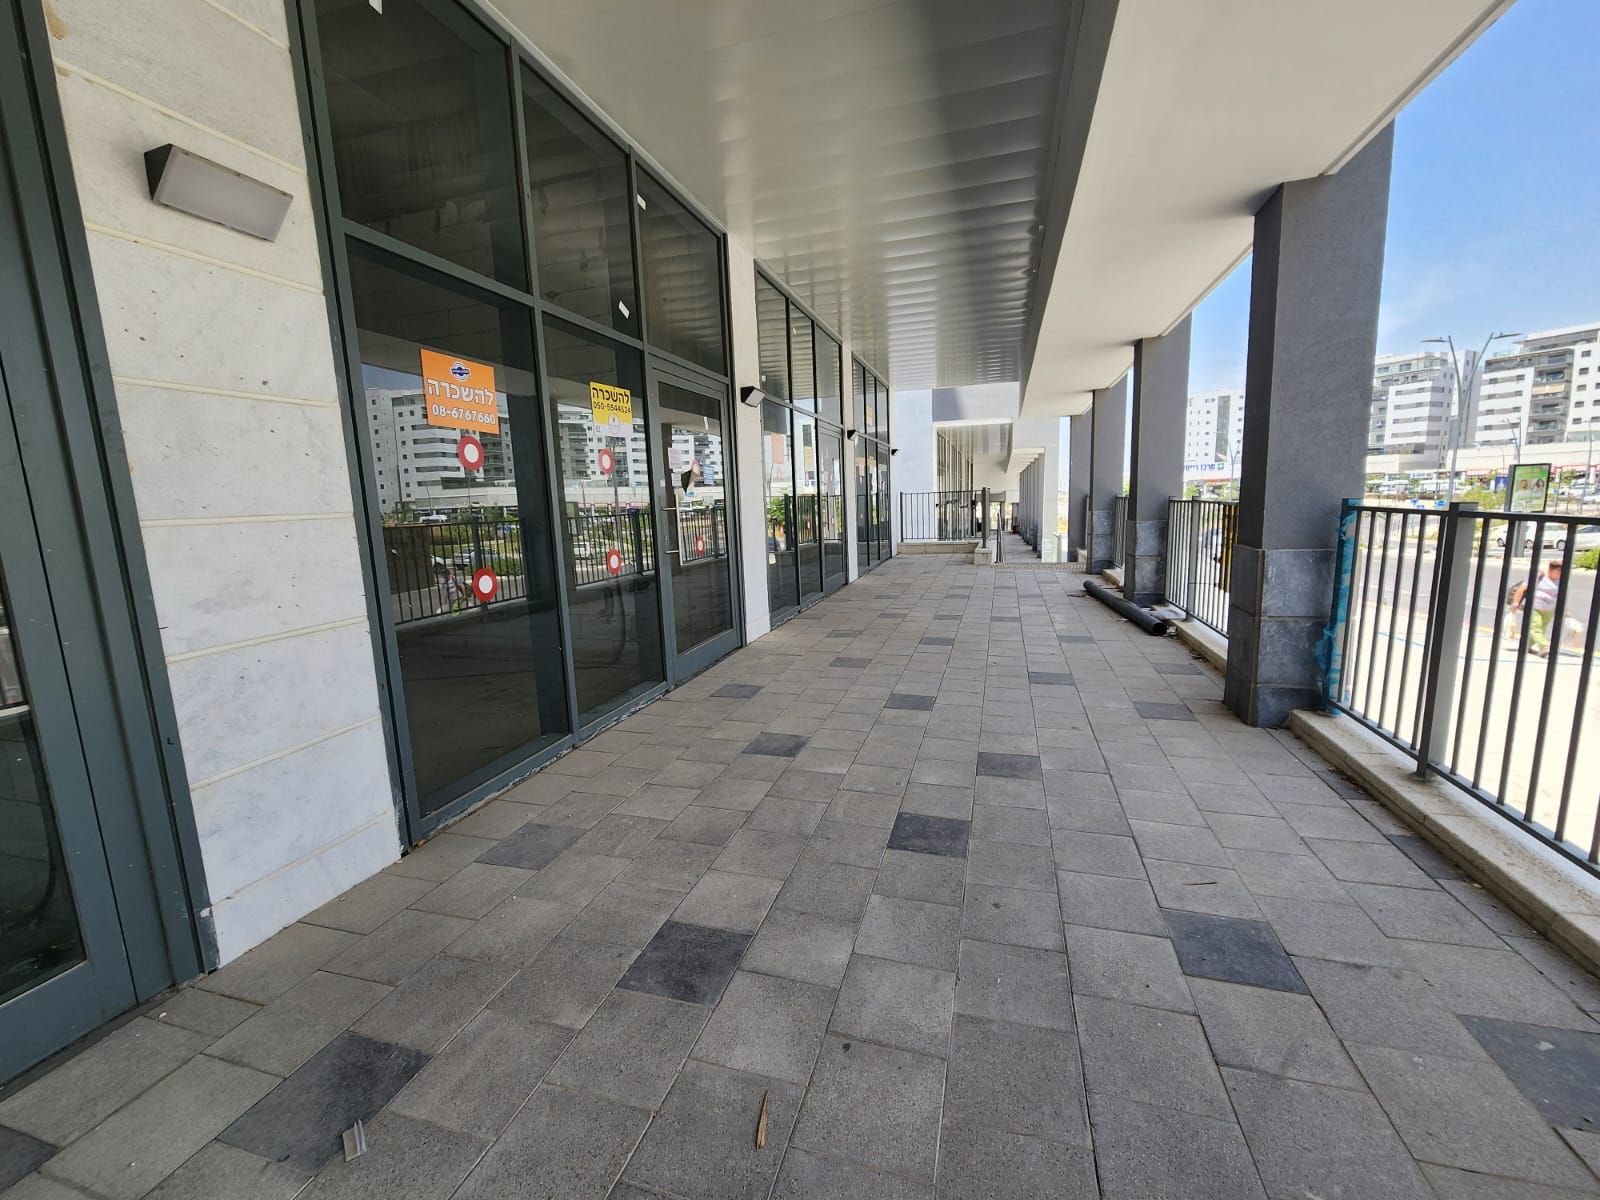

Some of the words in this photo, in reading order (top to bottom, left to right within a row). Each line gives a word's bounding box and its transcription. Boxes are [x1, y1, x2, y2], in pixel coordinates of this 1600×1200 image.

[427, 378, 494, 406] להשכרה
[592, 387, 630, 404] להשכרה
[432, 404, 496, 425] 08-6767660
